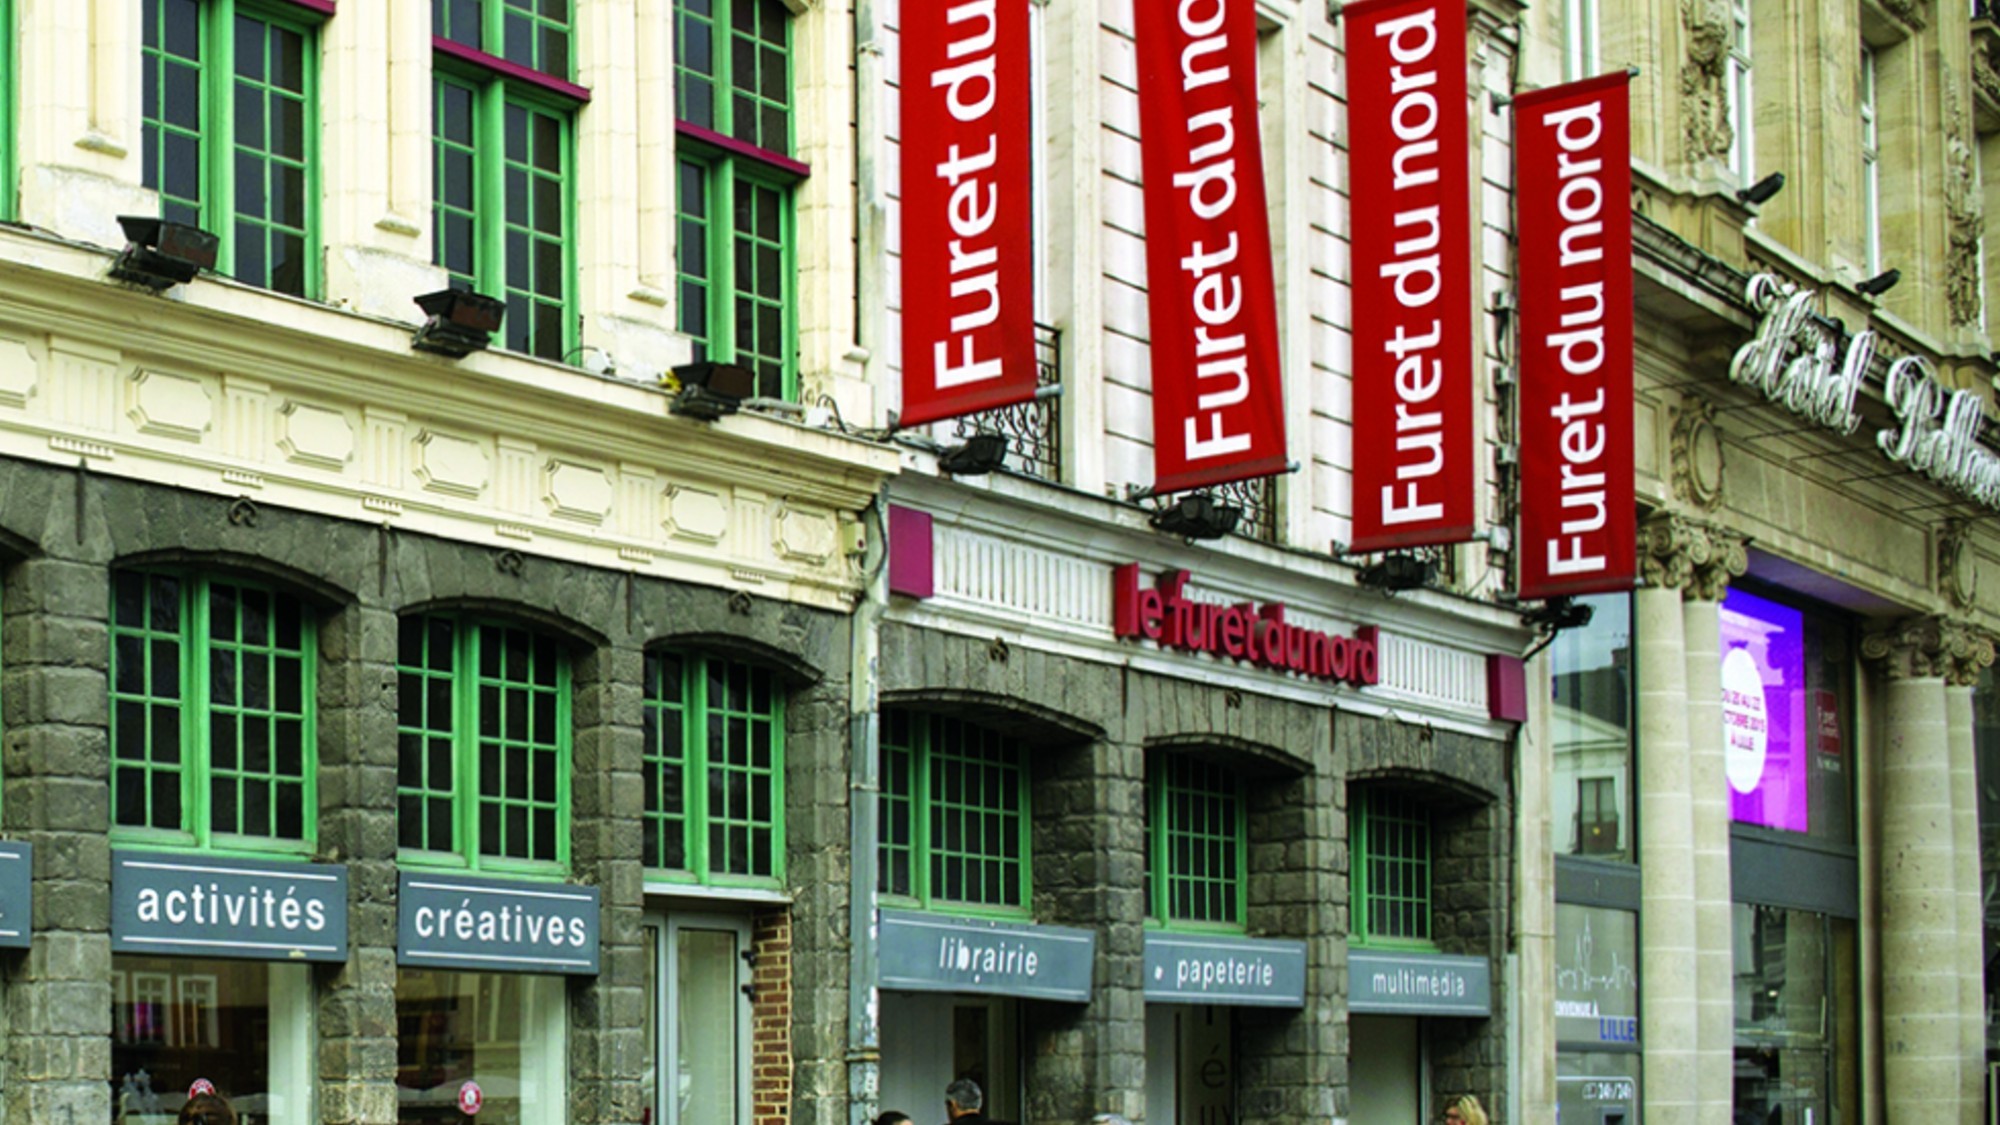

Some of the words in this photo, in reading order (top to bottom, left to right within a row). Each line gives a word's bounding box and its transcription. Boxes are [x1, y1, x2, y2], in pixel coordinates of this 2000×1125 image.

[930, 0, 998, 122] du
[1375, 8, 1439, 190] nord
[1172, 105, 1238, 220] du
[1543, 100, 1603, 267] nord
[934, 133, 1003, 390] Furet
[1379, 205, 1441, 308] du
[1180, 231, 1252, 461] Furet
[1546, 281, 1605, 375] du
[1381, 319, 1444, 526] Furet
[1547, 387, 1607, 576] Furet
[1115, 561, 1164, 640] le
[1158, 568, 1260, 662] furet
[1261, 601, 1311, 670] du
[1309, 624, 1380, 686] nord
[137, 883, 326, 931] activités
[415, 898, 587, 947] créatives
[939, 937, 1039, 976] librairie
[1177, 957, 1274, 991] papeterie
[1373, 968, 1466, 997] multimédia
[1600, 1016, 1637, 1042] LILLE
